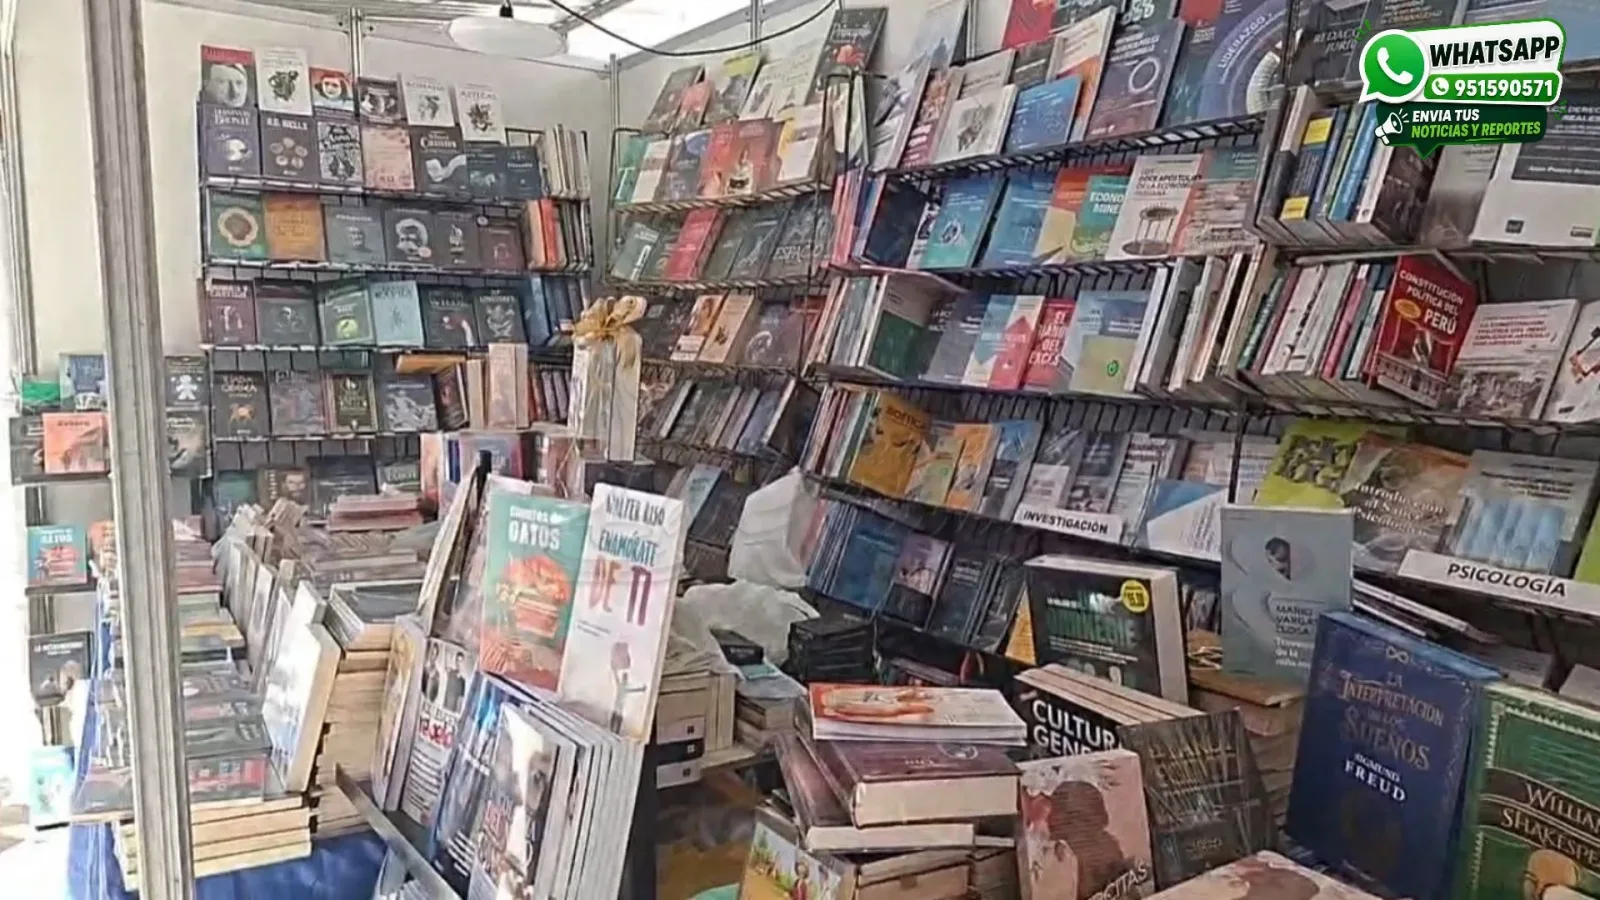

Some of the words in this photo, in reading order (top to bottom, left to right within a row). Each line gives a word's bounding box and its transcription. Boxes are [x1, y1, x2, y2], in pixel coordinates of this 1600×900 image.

[1217, 15, 1266, 69] LIDERAZGO
[1090, 192, 1126, 202] ECONO
[1093, 203, 1121, 214] MINE
[1424, 308, 1457, 336] PERÚ
[1444, 302, 1458, 317] DEL
[1024, 511, 1108, 534] INVESTIGACIÓN
[599, 529, 658, 567] ENAMÓRATE
[588, 554, 623, 613] DE
[627, 564, 652, 626] TI
[1447, 563, 1566, 597] PSICOLOGÍA
[1276, 615, 1315, 626] VARGA
[1033, 699, 1116, 750] CULTUR
[1344, 759, 1406, 801] FREUD
[1354, 753, 1400, 783] SIGMUND
[1525, 782, 1600, 834] WILLIA
[1501, 807, 1600, 869] SHAKESPE
